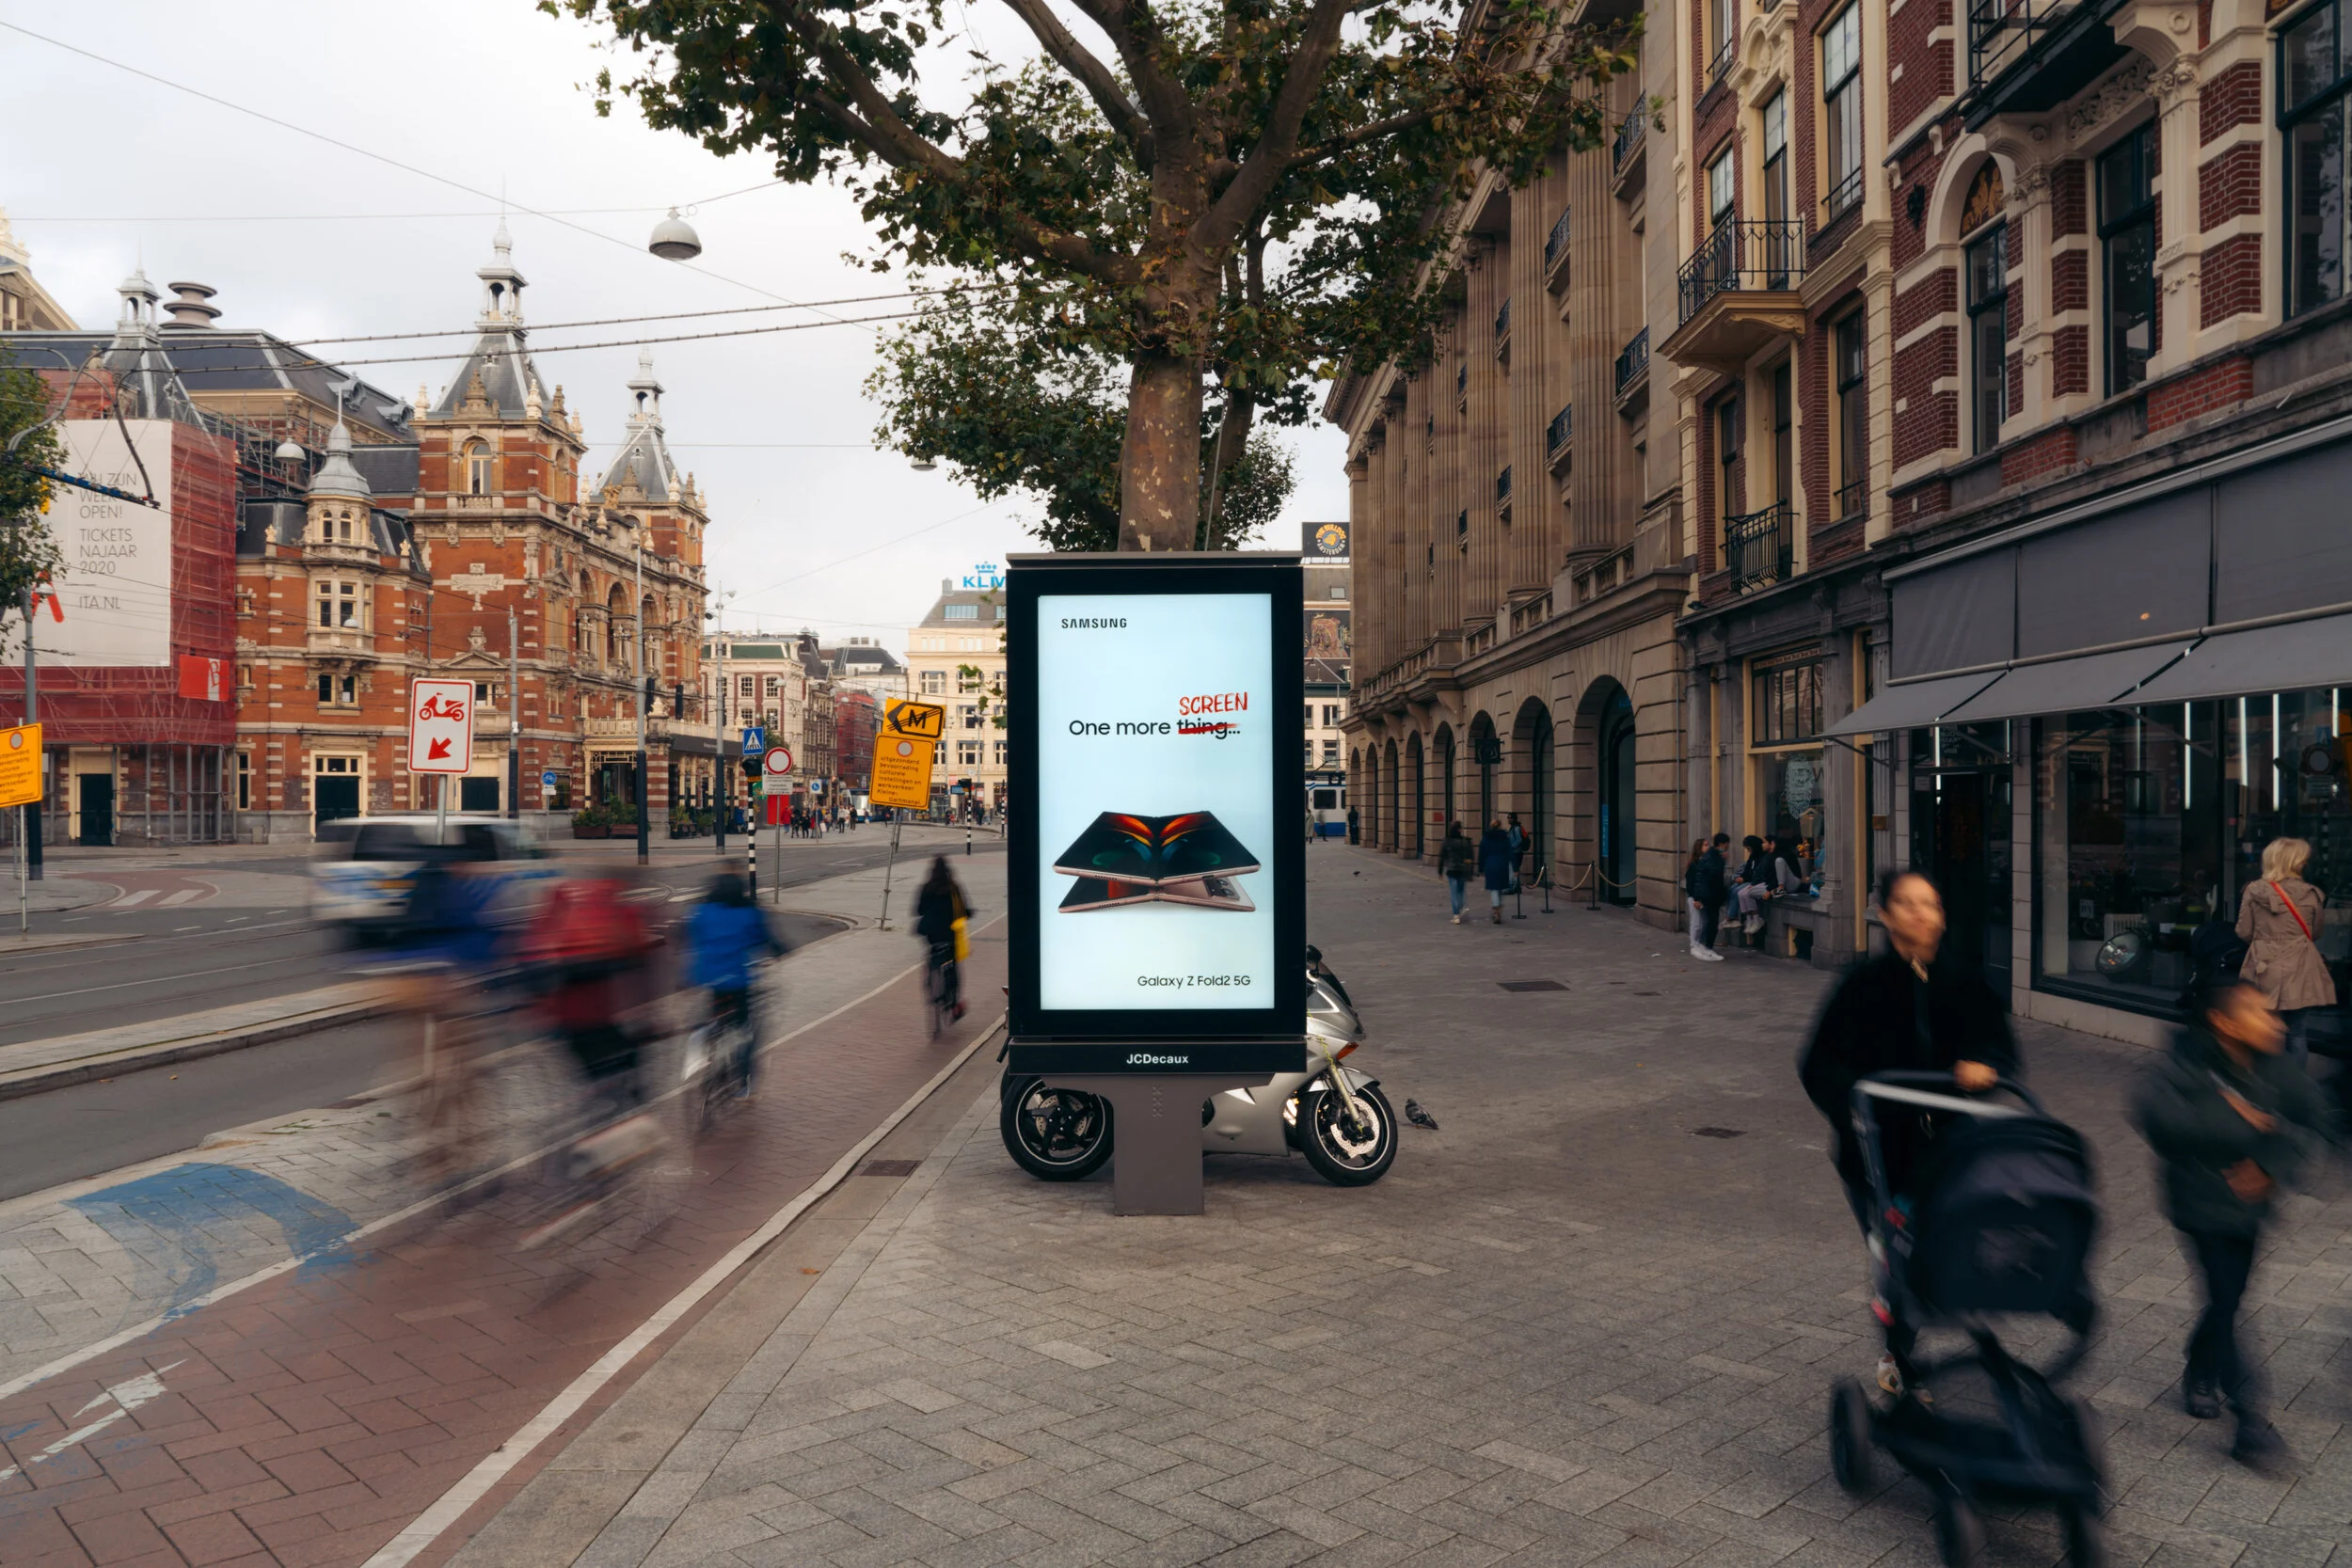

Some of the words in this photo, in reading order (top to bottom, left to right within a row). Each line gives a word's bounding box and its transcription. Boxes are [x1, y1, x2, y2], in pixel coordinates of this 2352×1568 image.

[79, 505, 122, 519] OPEN!
[79, 528, 133, 542] TICKETS
[80, 545, 137, 558] NAJAAR
[1317, 542, 1345, 555] AMSTERDAM
[80, 561, 116, 575] 2020
[79, 595, 120, 610] ITA.NL
[1061, 618, 1127, 628] SAMSUNG
[1179, 691, 1248, 715] SCREEN
[908, 709, 927, 729] M
[1069, 720, 1111, 736] One
[1117, 721, 1170, 736] more
[1137, 975, 1184, 990] Galaxy
[1186, 975, 1194, 986] Z
[1197, 975, 1231, 986] Fold2
[1233, 975, 1251, 986] 5G
[1126, 1053, 1189, 1064] JCDecaux
